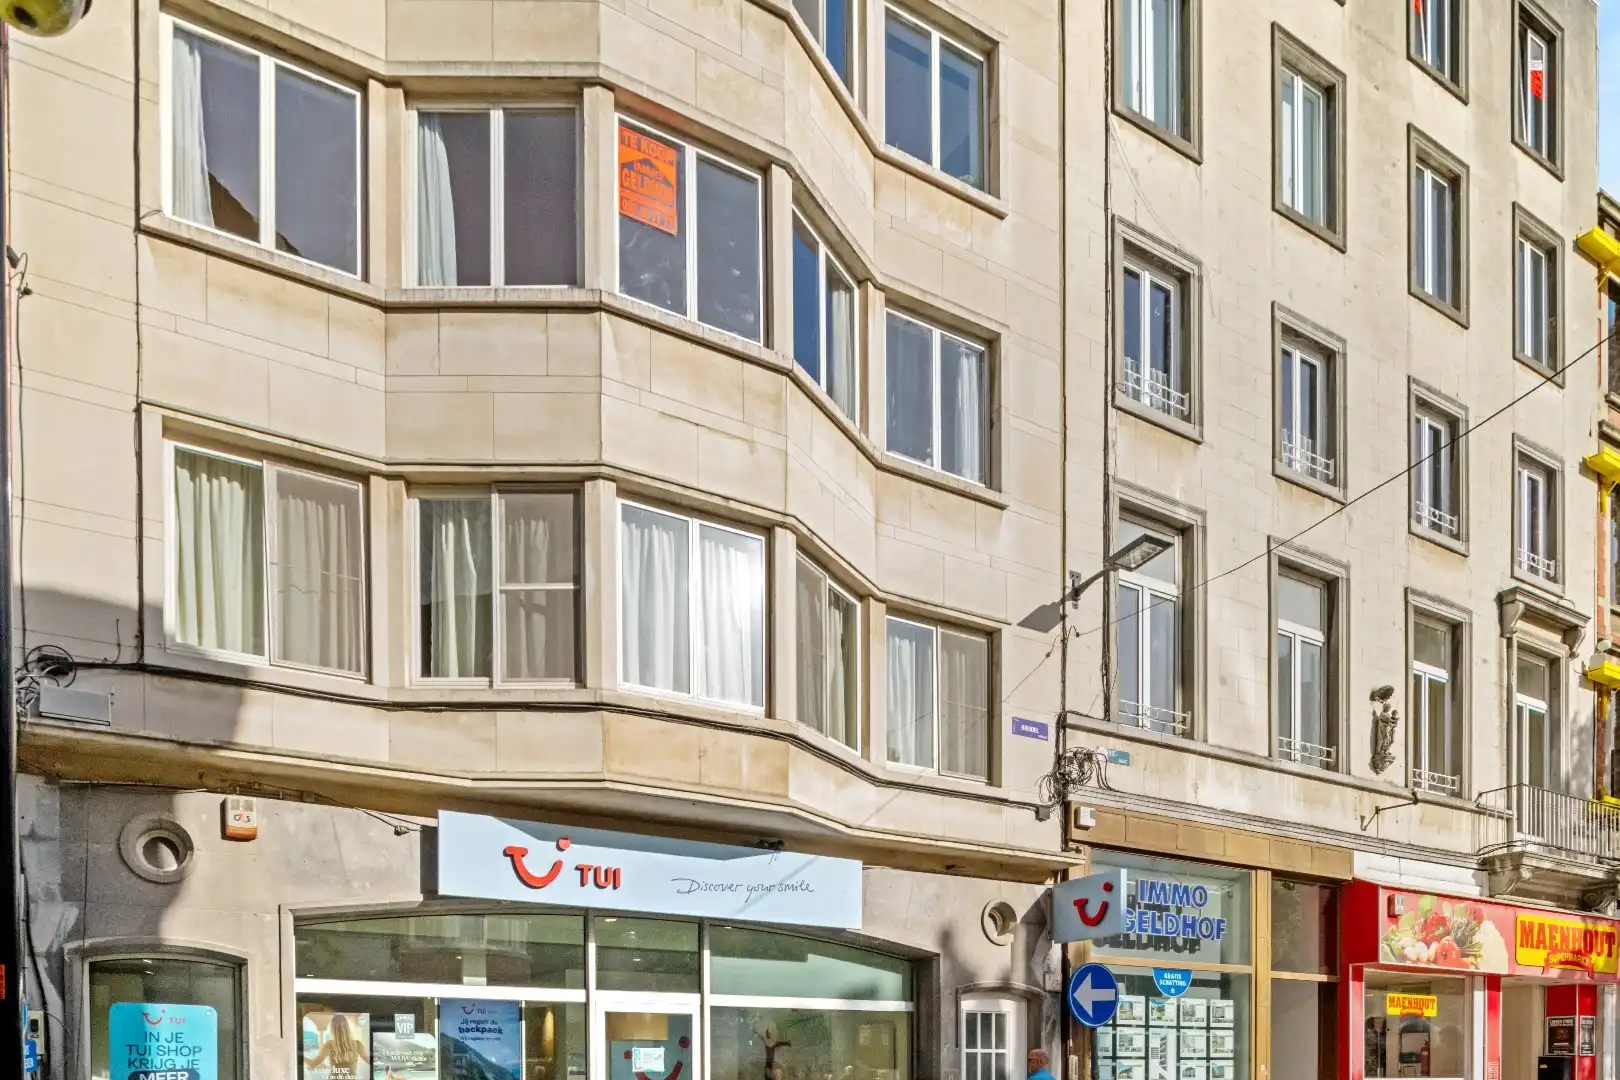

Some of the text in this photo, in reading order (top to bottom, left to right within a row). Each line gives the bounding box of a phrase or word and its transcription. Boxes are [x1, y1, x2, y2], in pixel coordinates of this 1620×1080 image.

[575, 863, 815, 903] TUI Discover your smile
[1137, 878, 1208, 909] IMMO
[1125, 907, 1226, 940] GELDHOF
[1519, 919, 1616, 958] MAENHOUT
[1163, 972, 1182, 980] GRATIS
[1388, 995, 1436, 1010] MAENHOUT
[168, 1016, 186, 1024] TUI
[396, 1022, 414, 1034] VIP
[458, 1025, 504, 1034] backpack
[144, 1031, 184, 1044] IN JE
[125, 1044, 202, 1057] TUI SHOP
[127, 1058, 200, 1070] KRIJG JE
[332, 1065, 351, 1074] luxe
[139, 1071, 189, 1080] MEER
